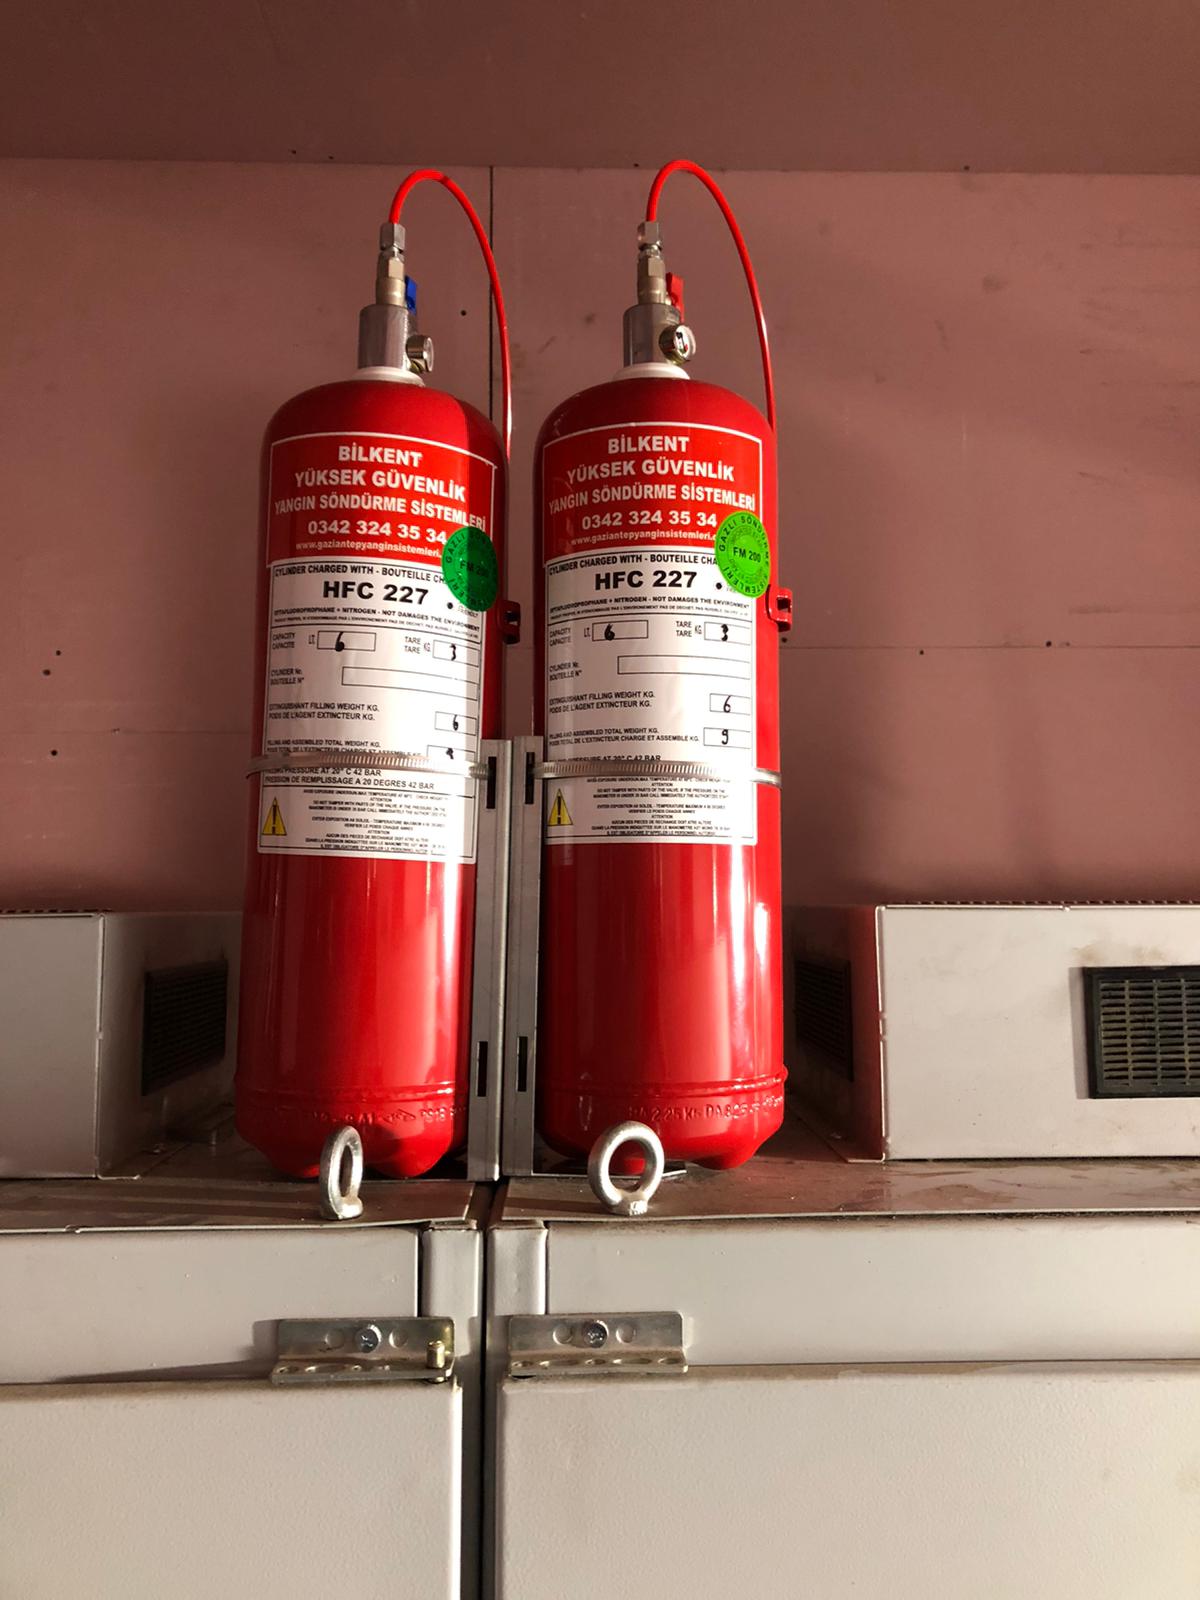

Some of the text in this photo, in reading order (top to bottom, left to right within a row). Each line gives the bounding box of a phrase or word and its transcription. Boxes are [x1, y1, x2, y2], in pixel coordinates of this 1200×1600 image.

[608, 433, 690, 454] BİLKENT
[338, 442, 422, 467] BİLKENT
[566, 456, 734, 484] YÜKSEK GÜVENLİK
[295, 468, 466, 502] YÜKSEK GÜVENLİK
[548, 481, 756, 516] YANGIN SÖNDÜRME SİSTEMLERİ
[274, 491, 486, 532] YANGIN SÖNDÜRME SİSTEMLERİ
[582, 510, 717, 530] 0342 324 35 34
[308, 521, 447, 544] 0342 324 35 34
[296, 539, 442, 558] www.gaziantepyanginsistemleri.
[733, 546, 761, 562] FM 200
[549, 561, 578, 575] CYLINDER
[580, 556, 618, 569] CHARGED
[619, 554, 642, 563] WITH
[650, 554, 698, 564] BOUTEILLE
[275, 565, 306, 577] CYLINDER
[308, 565, 348, 574] CHARGED
[350, 565, 374, 575] WITH
[381, 567, 431, 582] BOUTEILLE
[595, 570, 697, 591] HFC 227
[323, 581, 374, 600] HFC
[383, 584, 429, 605] 227
[398, 611, 429, 620] DAMAGES
[273, 632, 295, 641] CAPACITY
[405, 636, 421, 645] TARE
[549, 627, 571, 638] CAPACITY
[604, 624, 615, 641] 6
[676, 630, 692, 638] TARE
[721, 624, 729, 642] 3
[335, 632, 345, 652] 6
[404, 645, 420, 654] TARE
[549, 662, 571, 673] CYLINDER
[549, 671, 574, 681] BOUTEILLE
[588, 692, 613, 700] FILLING
[614, 691, 641, 699] WEIGHT
[723, 694, 732, 713] 6
[337, 703, 366, 711] WEIGHT
[366, 704, 380, 712] KG.
[562, 705, 569, 713] DE
[570, 702, 594, 712] L'AGENT
[596, 700, 638, 710] EXTINCTEUR
[317, 712, 360, 720] EXTINCTEUR
[453, 714, 459, 731] 6
[573, 728, 604, 737] ASSEMBLED
[581, 735, 619, 743] L'EXTINCTEUR
[721, 728, 729, 745] 9
[301, 776, 353, 785] REMPLISSAGE
[355, 777, 363, 785] A
[363, 777, 372, 786] 20
[373, 779, 407, 788] DEGRES
[408, 781, 417, 789] 42
[419, 782, 434, 790] BAR
